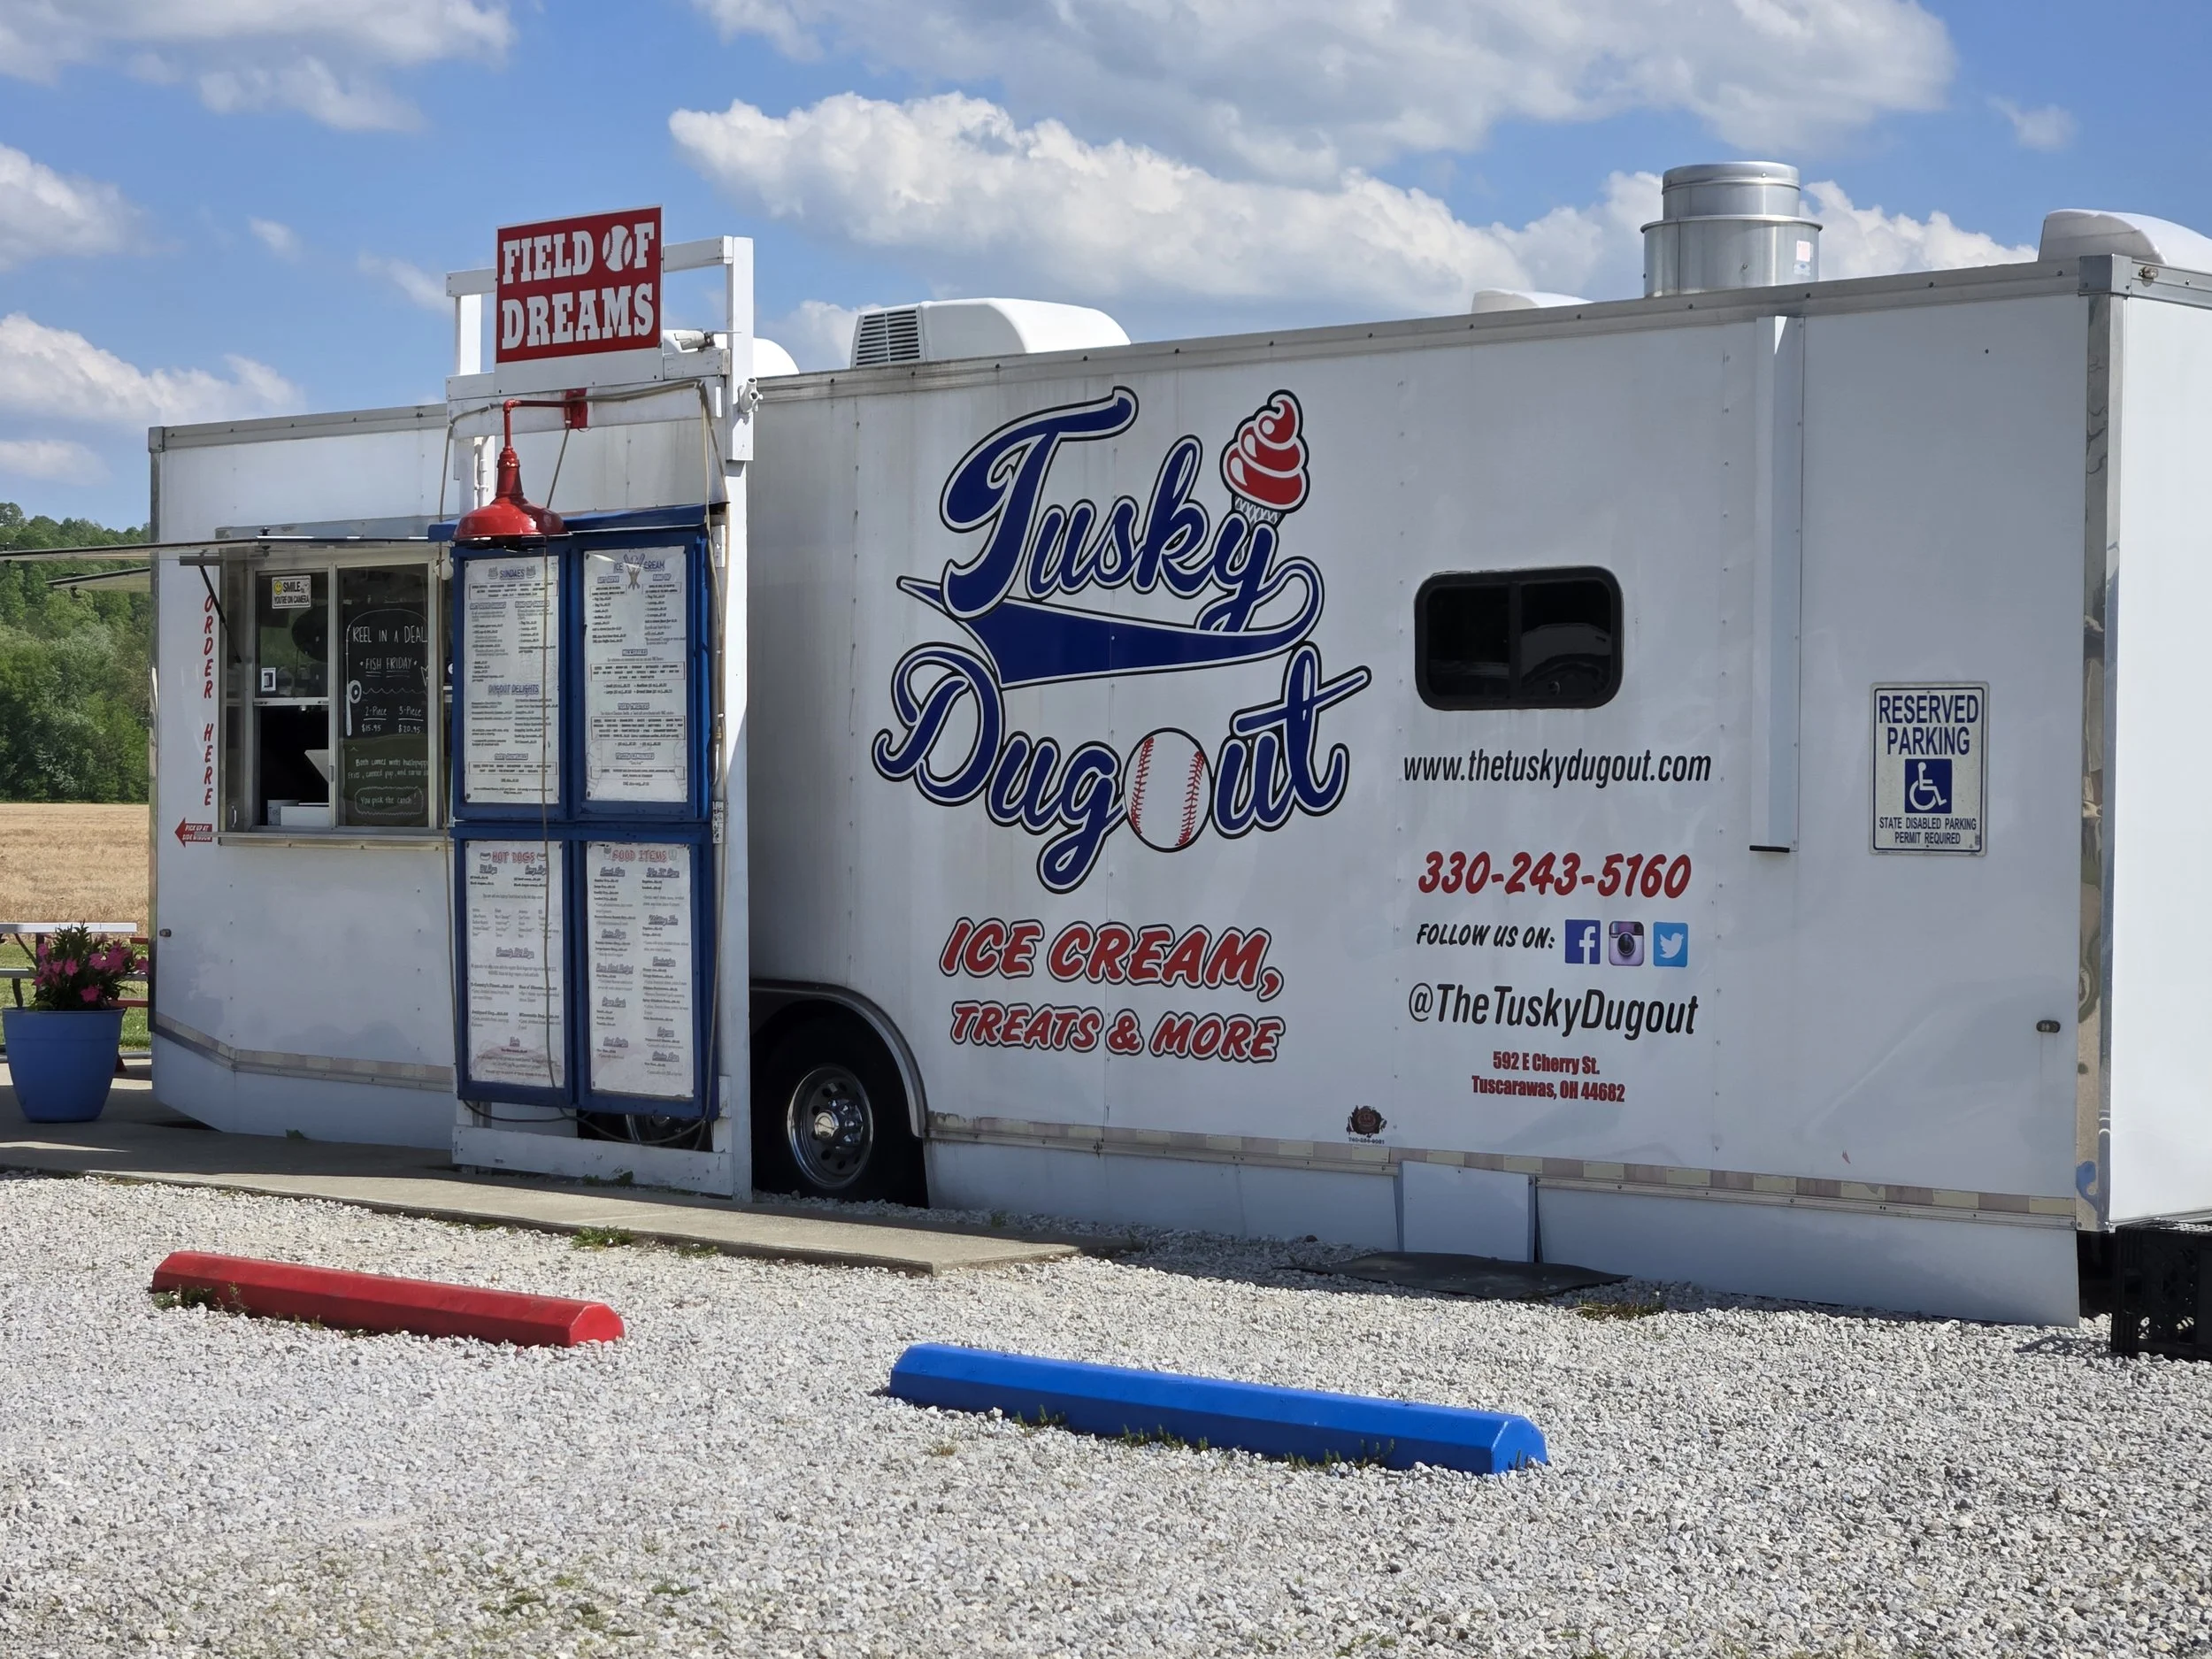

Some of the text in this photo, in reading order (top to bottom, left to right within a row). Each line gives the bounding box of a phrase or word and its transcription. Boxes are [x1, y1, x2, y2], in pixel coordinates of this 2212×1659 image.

[503, 230, 594, 284] FIELD
[502, 283, 654, 349] DREAMS
[940, 386, 1325, 633] Tusky
[500, 568, 525, 578] SUNDAES
[379, 629, 388, 642] IN
[394, 630, 399, 643] A
[404, 626, 428, 643] DEAL
[365, 657, 412, 670] FISH FRIDAY
[204, 594, 213, 806] ORDER HERE
[1878, 695, 1979, 724] RESERVED
[1887, 726, 1970, 756] PARKING
[872, 641, 1372, 894] Dugout
[1403, 748, 1711, 788] www.thetuskydugout.com
[1878, 817, 1977, 831] STATE DISABLED PARKING
[1895, 832, 1921, 843] PERMIT
[1924, 833, 1961, 845] REQUIRED
[492, 851, 535, 864] HOT DOGS
[639, 849, 667, 863] ITEMS
[1417, 851, 1692, 899] 330-243-5160
[1416, 923, 1490, 947] FOLLOW
[1493, 926, 1521, 948] US
[1522, 926, 1555, 949] ON:
[940, 917, 1284, 1002] ICE CREAM,
[1409, 982, 1699, 1040] @TheTuskyDugout
[949, 1000, 1286, 1064] TREATS & MORE
[1493, 1051, 1600, 1074] 592 E Cherry St.
[1471, 1075, 1625, 1102] Tuscarawas, OH 44682
